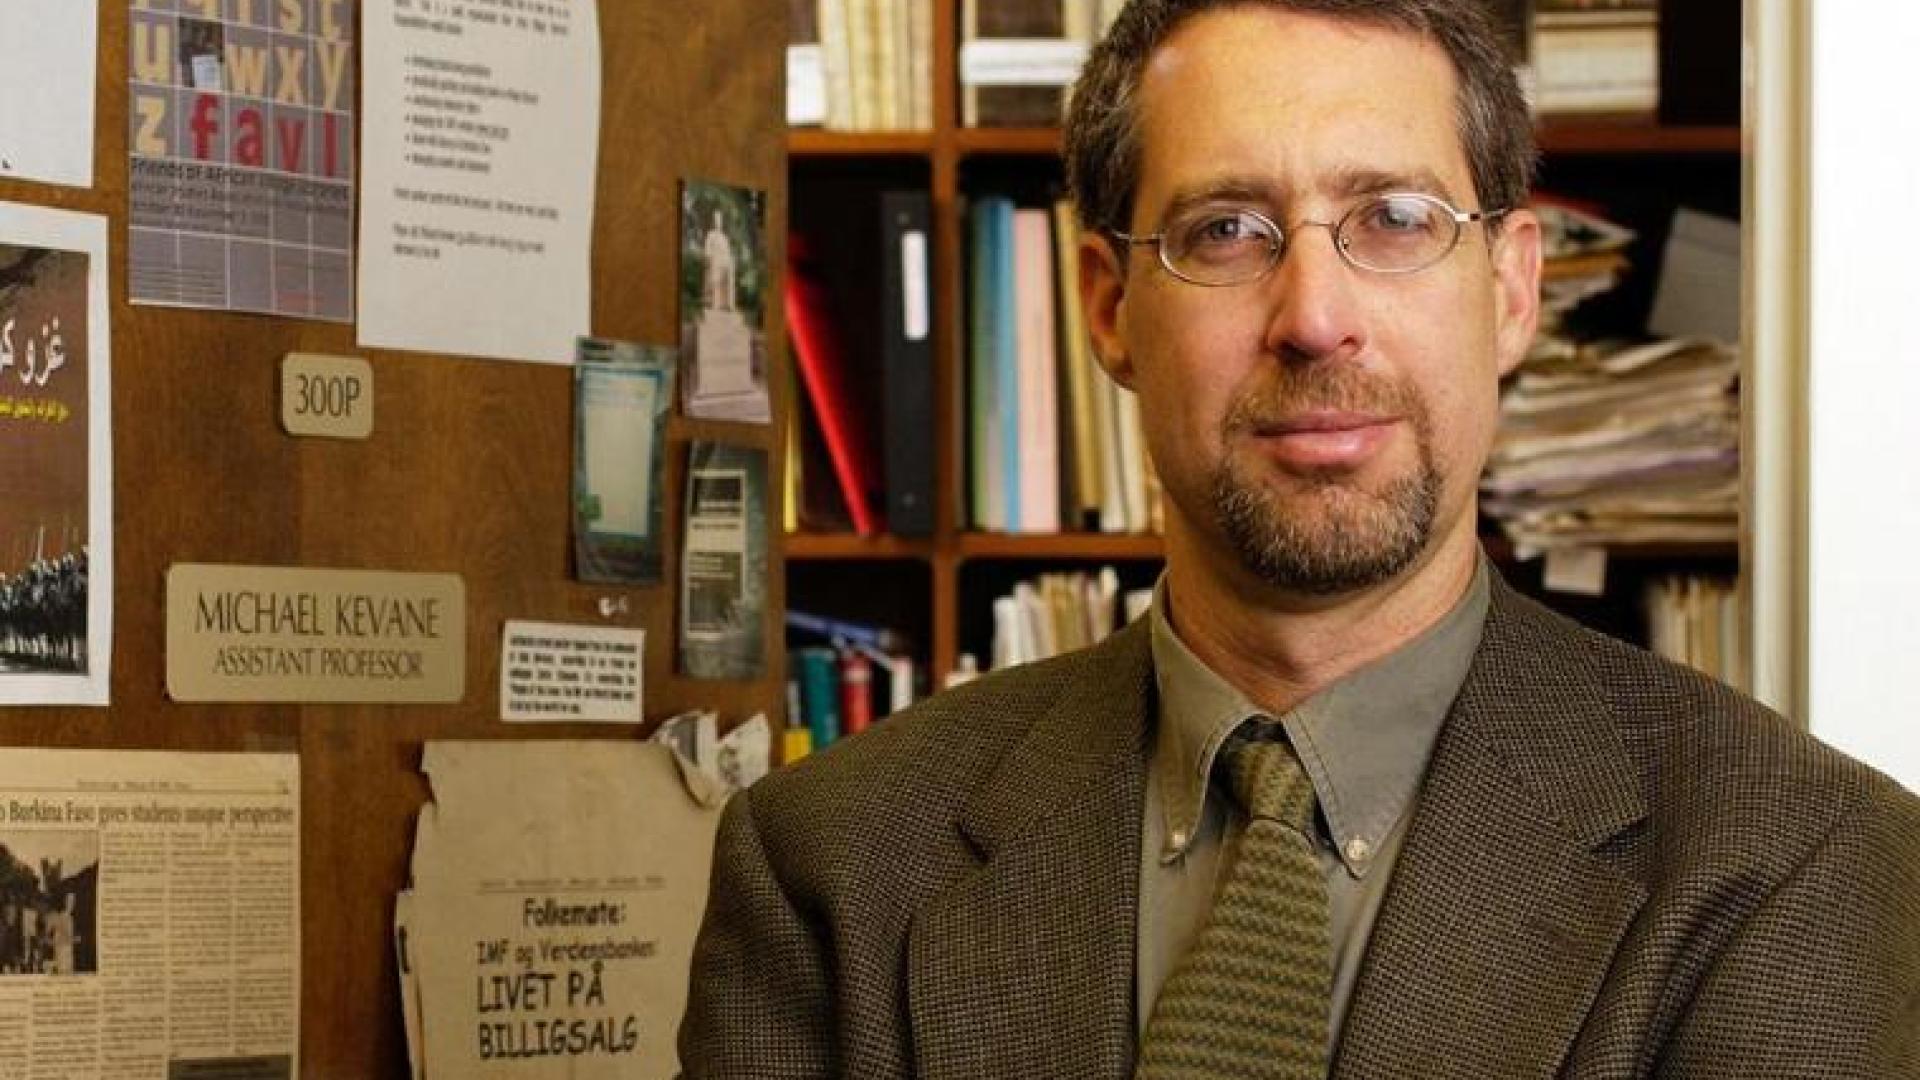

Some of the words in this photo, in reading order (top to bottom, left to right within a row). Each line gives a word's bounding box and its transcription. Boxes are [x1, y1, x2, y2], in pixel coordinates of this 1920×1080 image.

[293, 374, 362, 418] 300P
[195, 591, 325, 637] MICHAEL
[335, 594, 442, 640] KEVANE
[213, 646, 313, 676] ASSISTANT
[319, 647, 425, 680] PROFESSOR
[476, 938, 510, 965] IMF
[515, 946, 534, 969] og
[476, 973, 557, 1013] LIVET
[567, 959, 605, 1008] PÅ
[477, 1014, 639, 1060] BILLIGSALG
